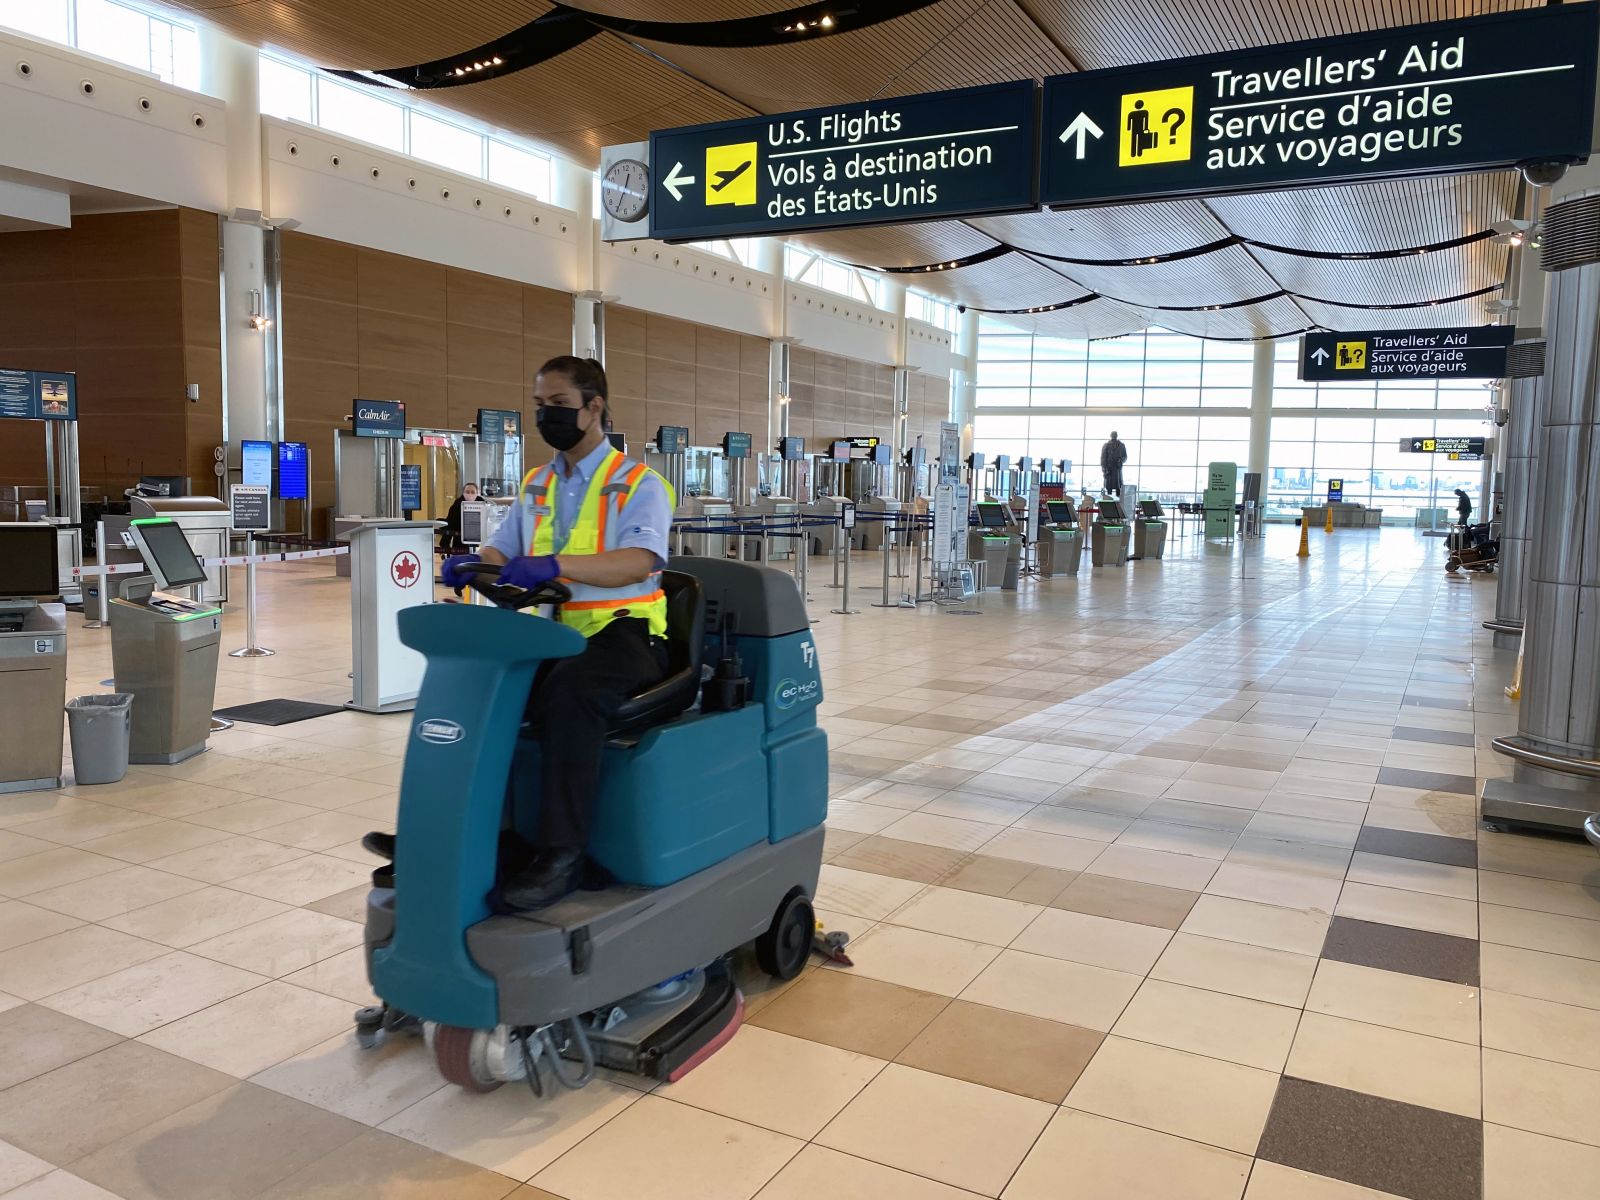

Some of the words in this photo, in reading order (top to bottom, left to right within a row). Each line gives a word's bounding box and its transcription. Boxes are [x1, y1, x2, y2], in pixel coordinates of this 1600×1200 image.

[1211, 49, 1387, 98] Travellers'
[1397, 36, 1465, 76] Aid
[768, 120, 811, 146] U.S.
[820, 109, 902, 142] Flights
[1208, 104, 1326, 141] Service
[1337, 86, 1453, 126] d'aide
[767, 159, 816, 187] Vols
[823, 157, 837, 181] à
[844, 142, 993, 179] destination
[1206, 142, 1266, 169] aux
[1276, 122, 1463, 167] voyageurs
[767, 193, 806, 219] des
[814, 179, 937, 214] États-Unis
[1371, 351, 1417, 363] Service
[1421, 349, 1464, 362] d'aide
[1373, 334, 1440, 348] Travellers'
[1443, 333, 1468, 345] Aid
[1370, 364, 1394, 373] aux
[1398, 362, 1467, 375] voyageurs
